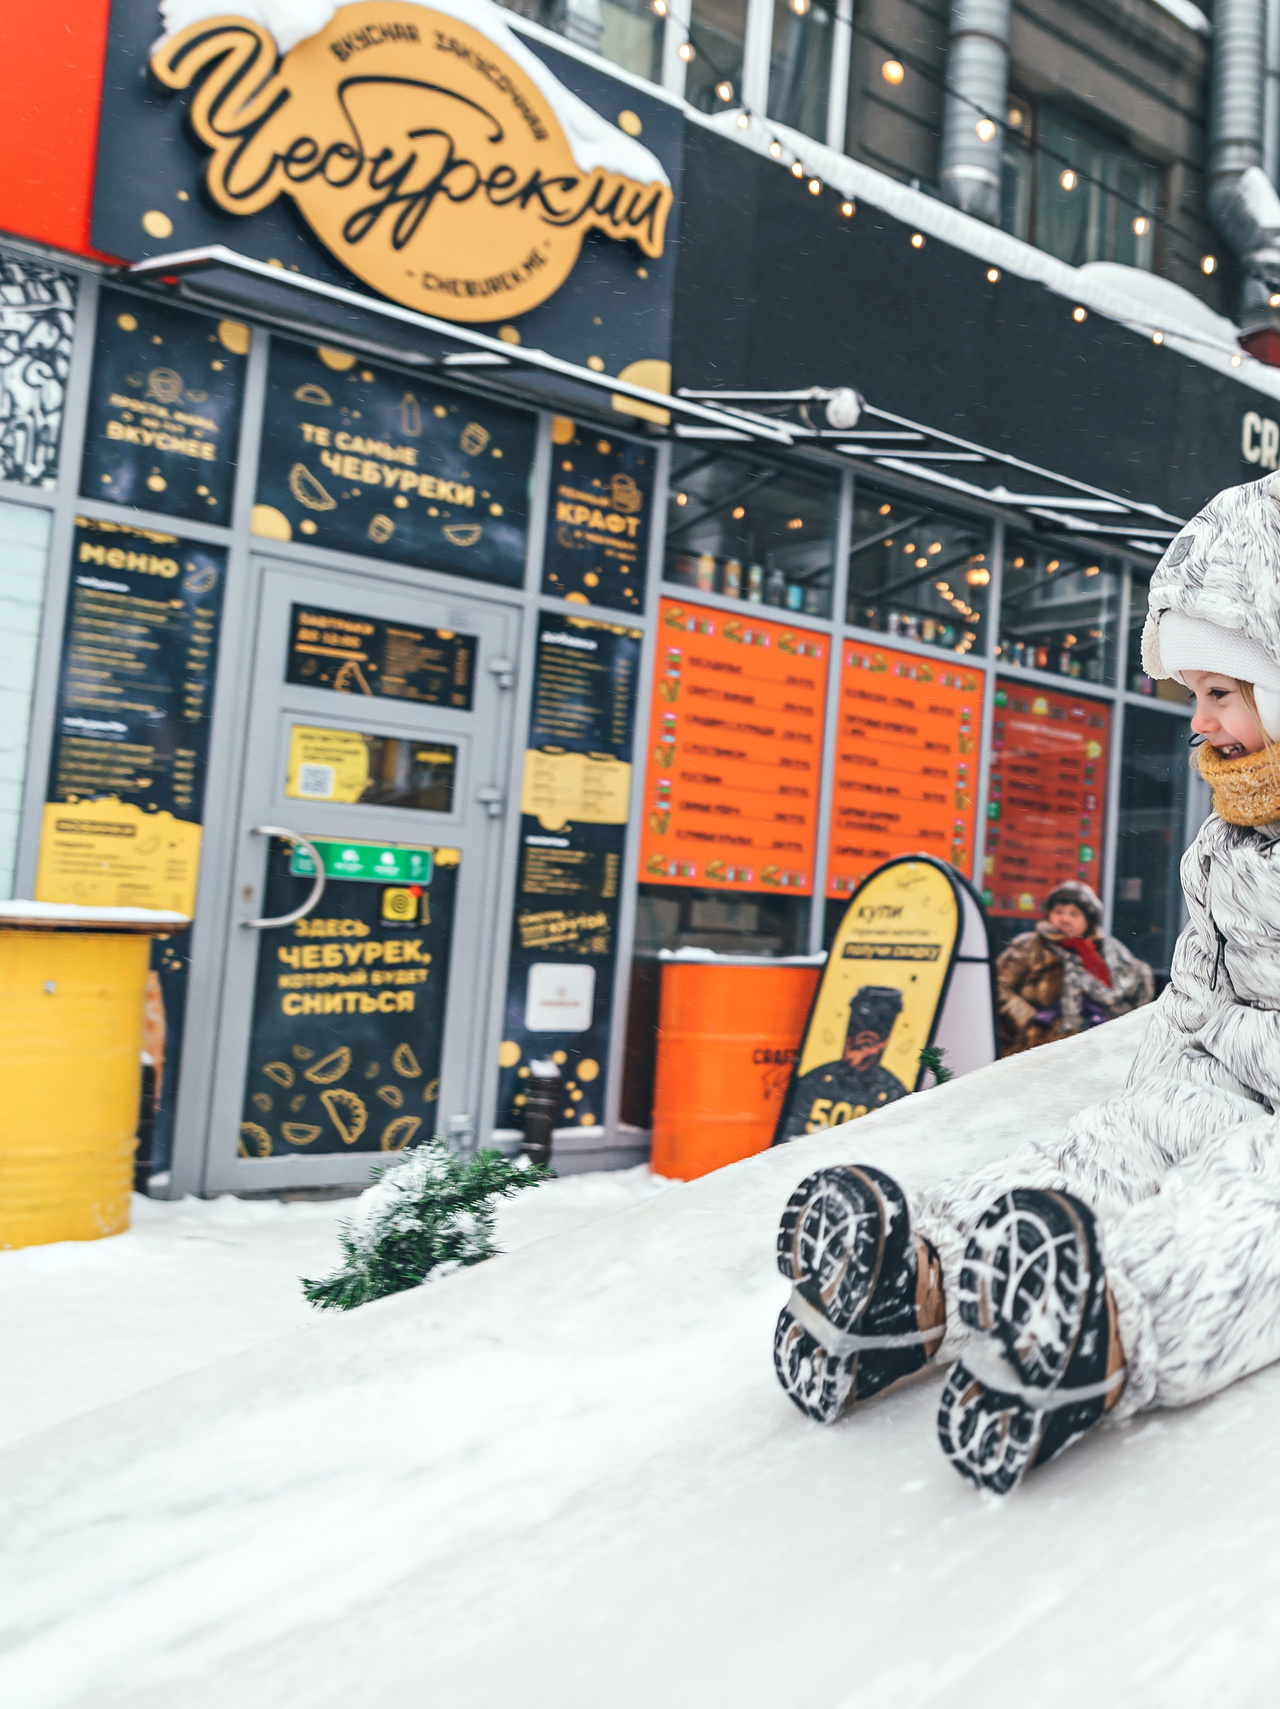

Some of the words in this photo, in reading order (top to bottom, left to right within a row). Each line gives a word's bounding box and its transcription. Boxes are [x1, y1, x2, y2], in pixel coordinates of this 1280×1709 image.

[106, 420, 217, 462] ВКУСНЕЕ
[301, 422, 333, 448] ТЕ
[334, 431, 418, 466] САМЫЕ
[319, 449, 476, 508] ЧЕБУРЕКИ
[556, 501, 641, 538] КРАФТ
[293, 918, 371, 938] ЗДЕСЬ
[277, 939, 432, 970] ЧЕБУРЕК,
[281, 990, 415, 1016] СНИТЬСЯ
